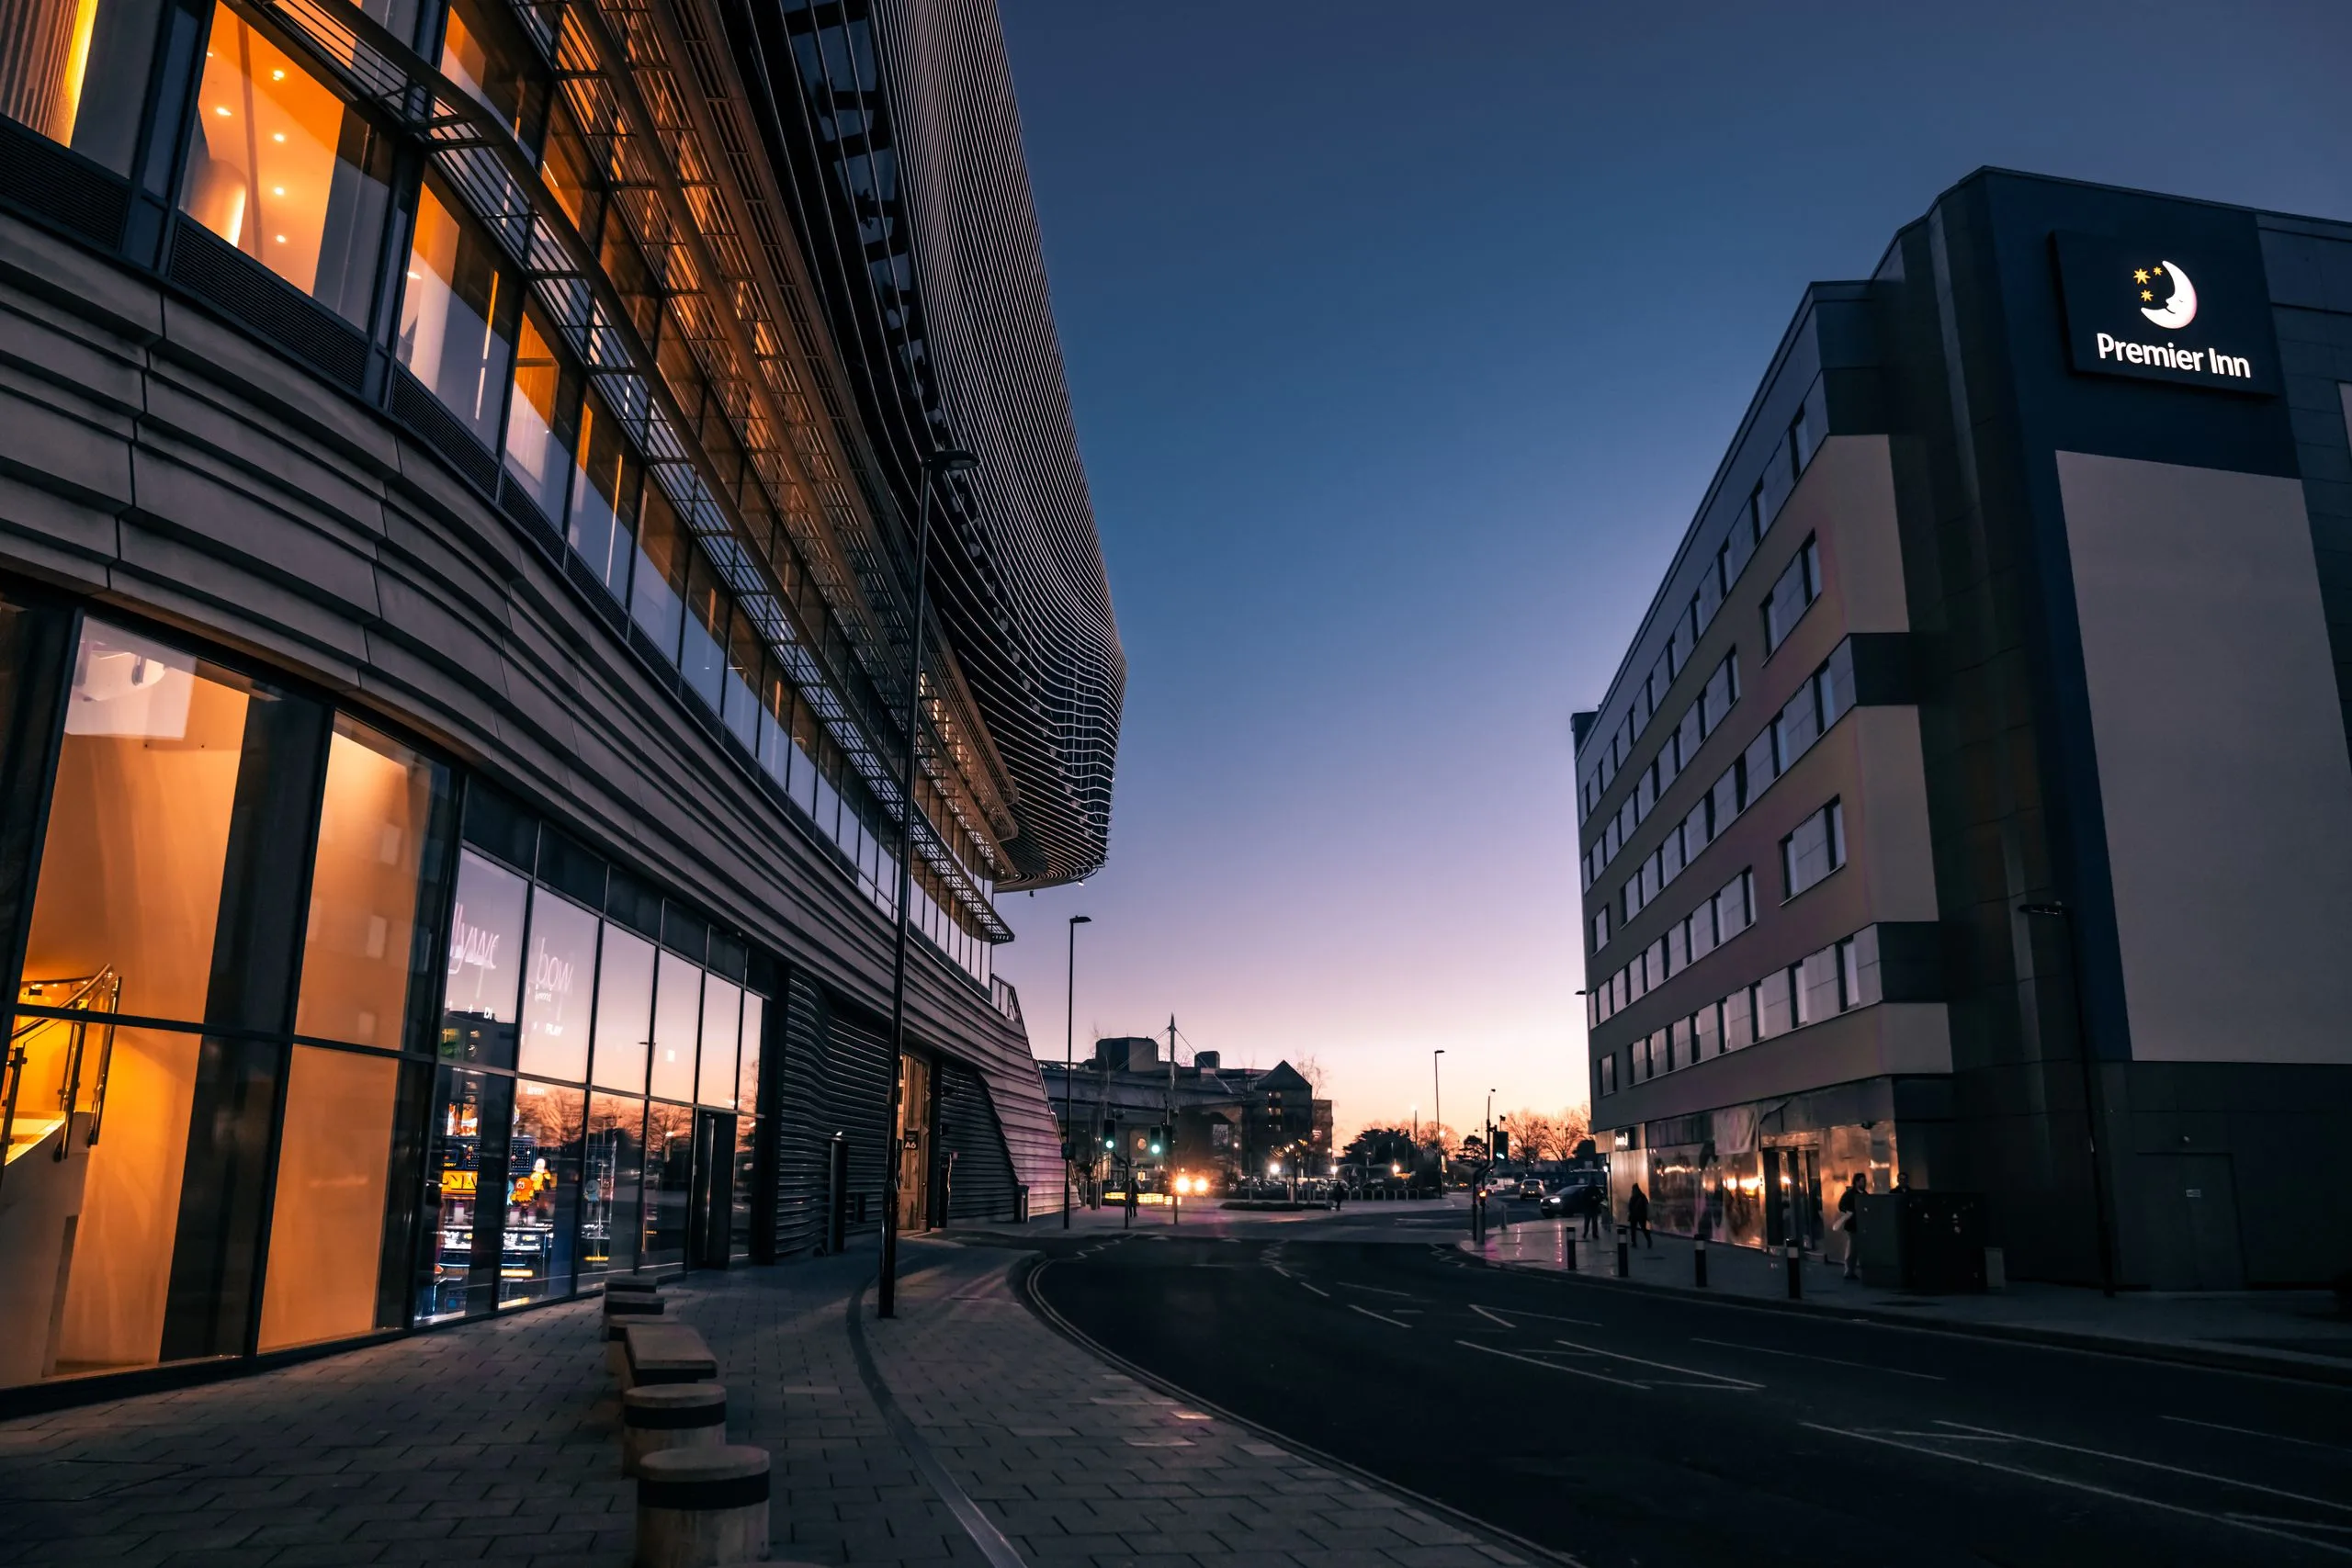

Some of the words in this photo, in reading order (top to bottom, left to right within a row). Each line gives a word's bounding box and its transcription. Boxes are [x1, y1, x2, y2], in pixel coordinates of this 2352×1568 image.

[2097, 333, 2204, 371] Premier
[2208, 347, 2251, 378] Inn
[904, 1141, 917, 1149] A6
